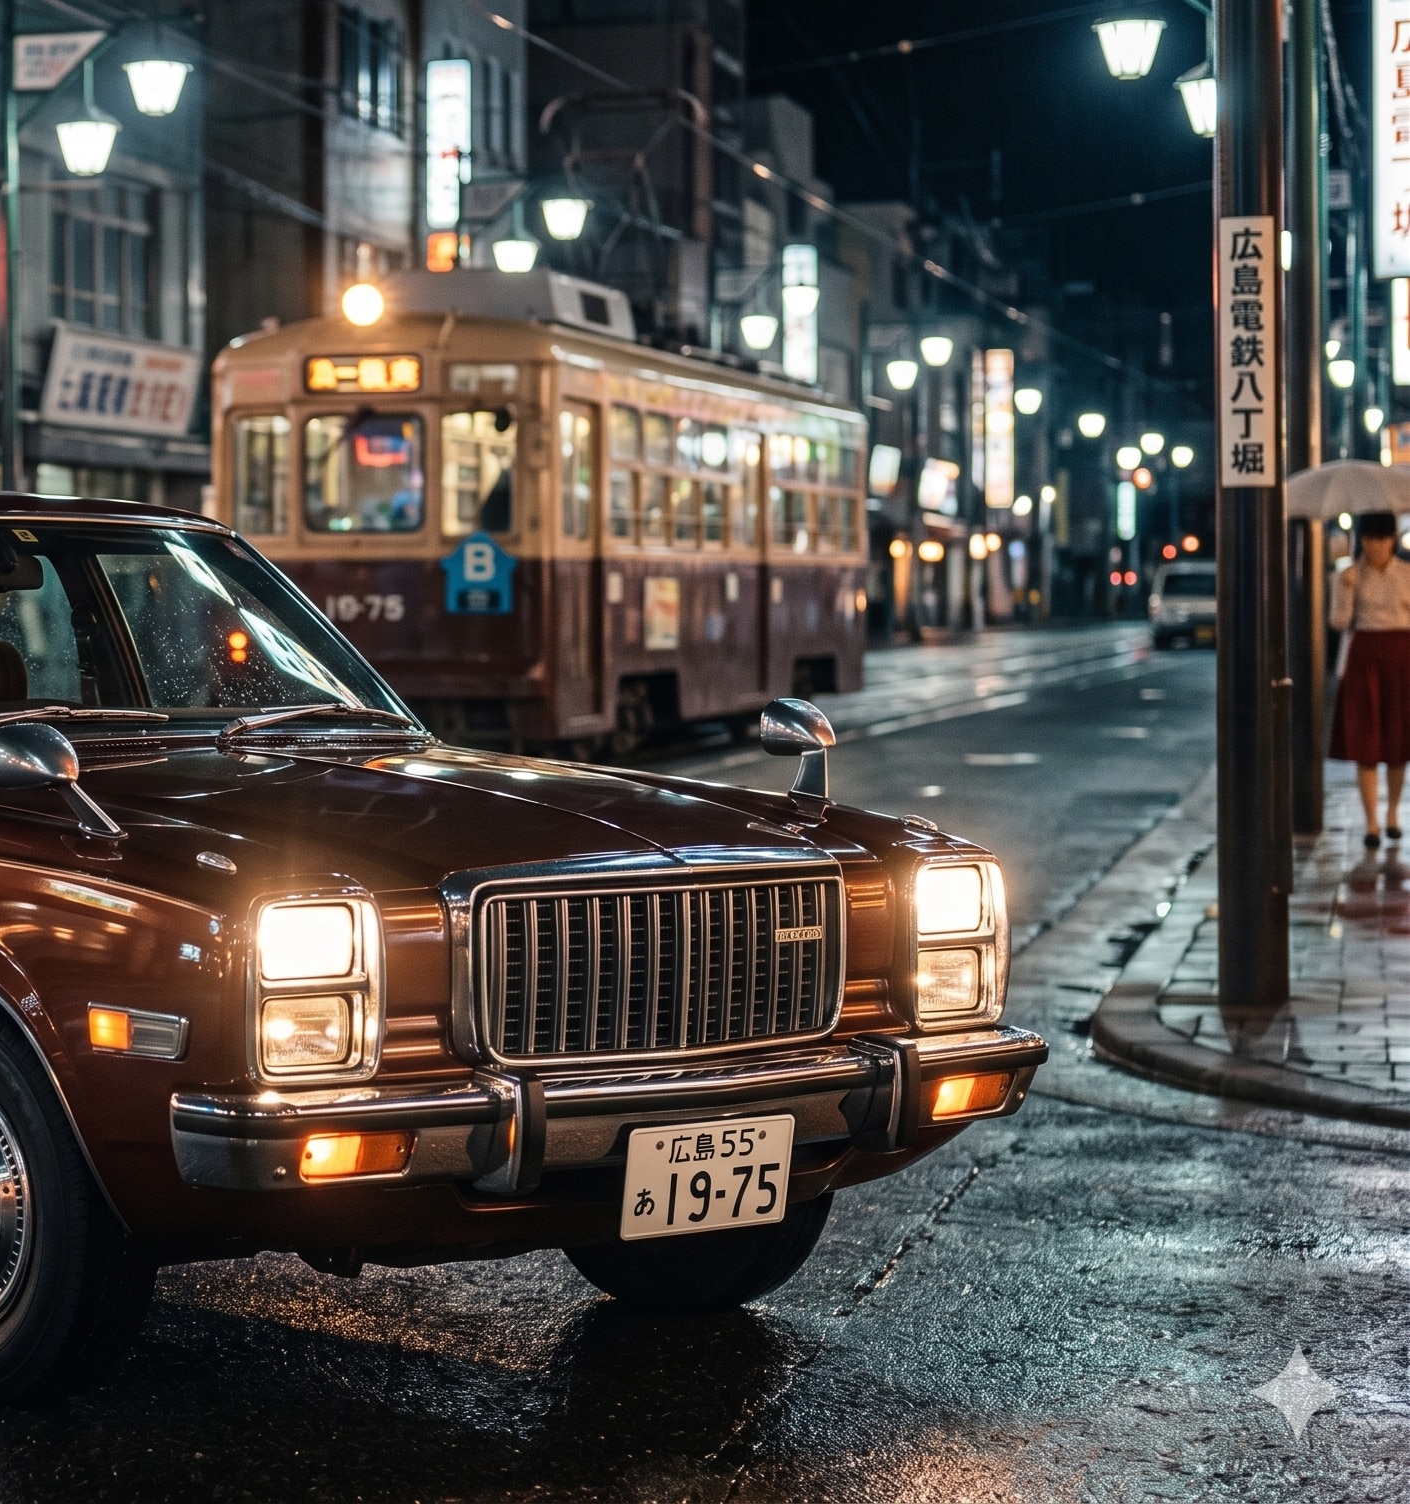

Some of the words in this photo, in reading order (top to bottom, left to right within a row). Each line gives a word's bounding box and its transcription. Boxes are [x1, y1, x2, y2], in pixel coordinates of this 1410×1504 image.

[1229, 227, 1265, 475] 広島電鉄八丁堀
[463, 542, 496, 582] B
[668, 1133, 715, 1164] 広島
[720, 1127, 756, 1158] 55
[633, 1188, 655, 1217] あ
[666, 1162, 781, 1226] 19-75
